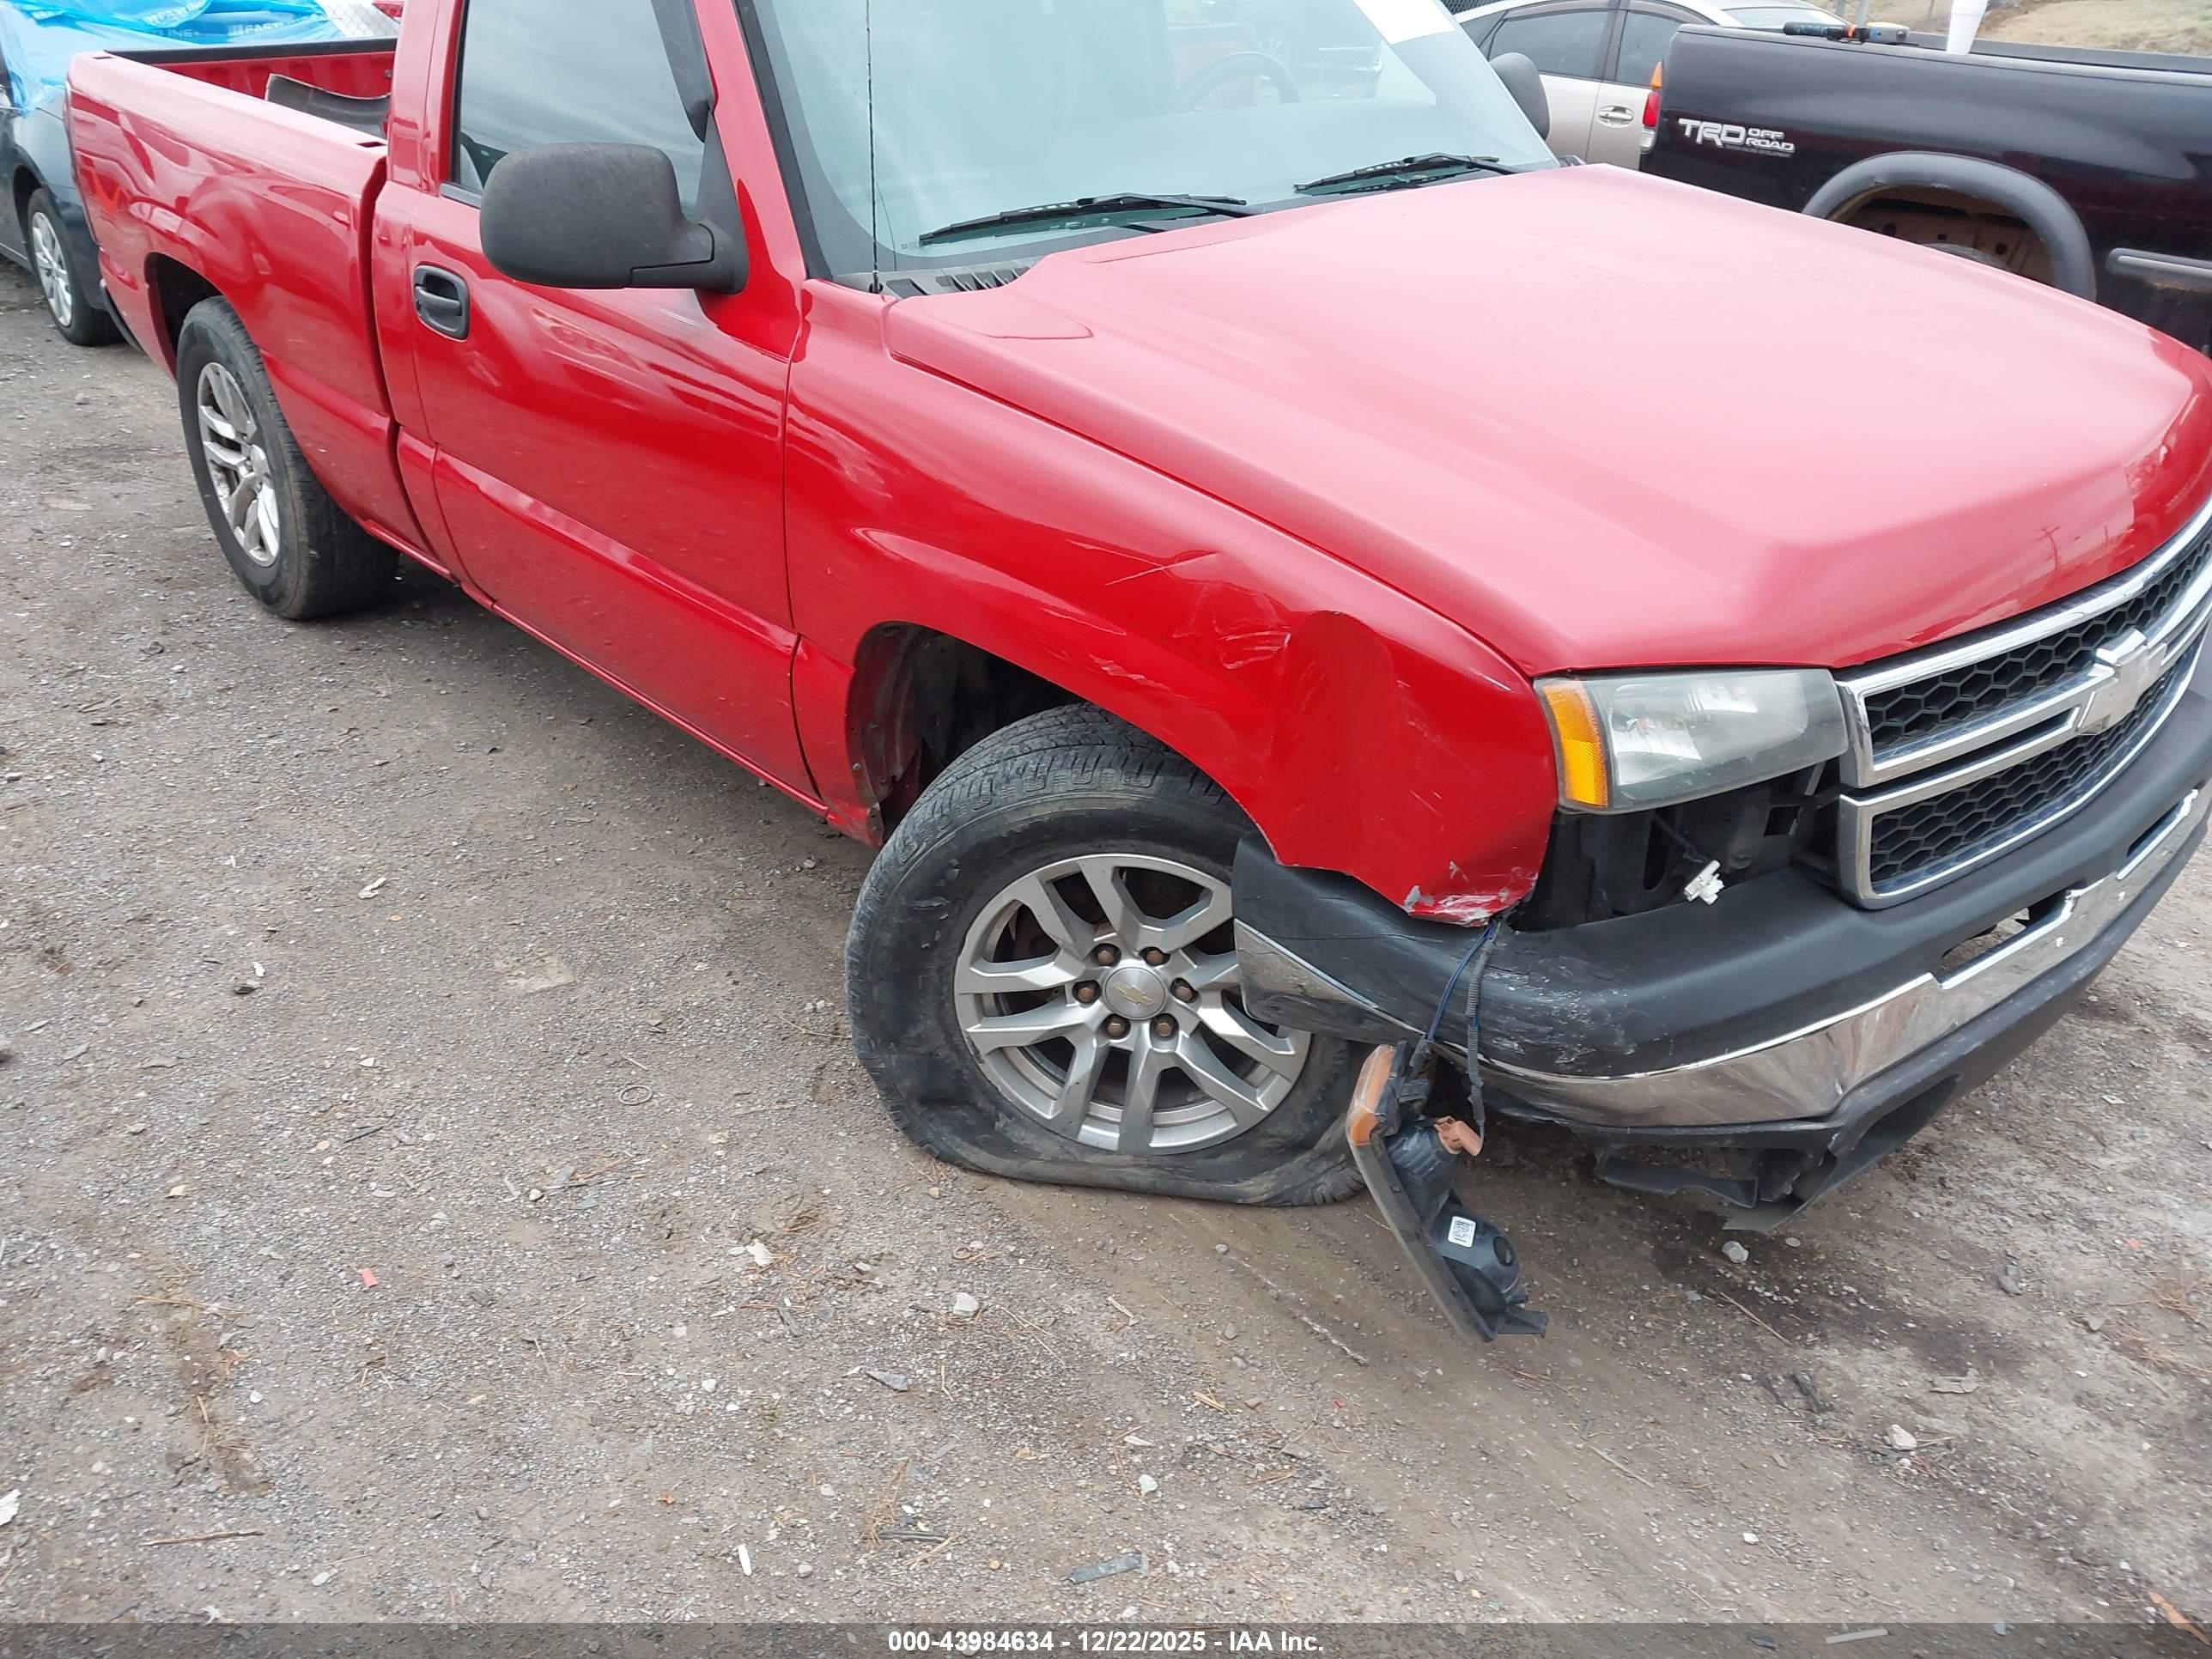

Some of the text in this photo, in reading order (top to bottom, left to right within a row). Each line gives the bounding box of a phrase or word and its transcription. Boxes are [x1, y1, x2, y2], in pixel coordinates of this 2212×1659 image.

[1678, 118, 1747, 148] TRD
[1747, 127, 1785, 140] OFF
[1746, 137, 1796, 154] ROAD
